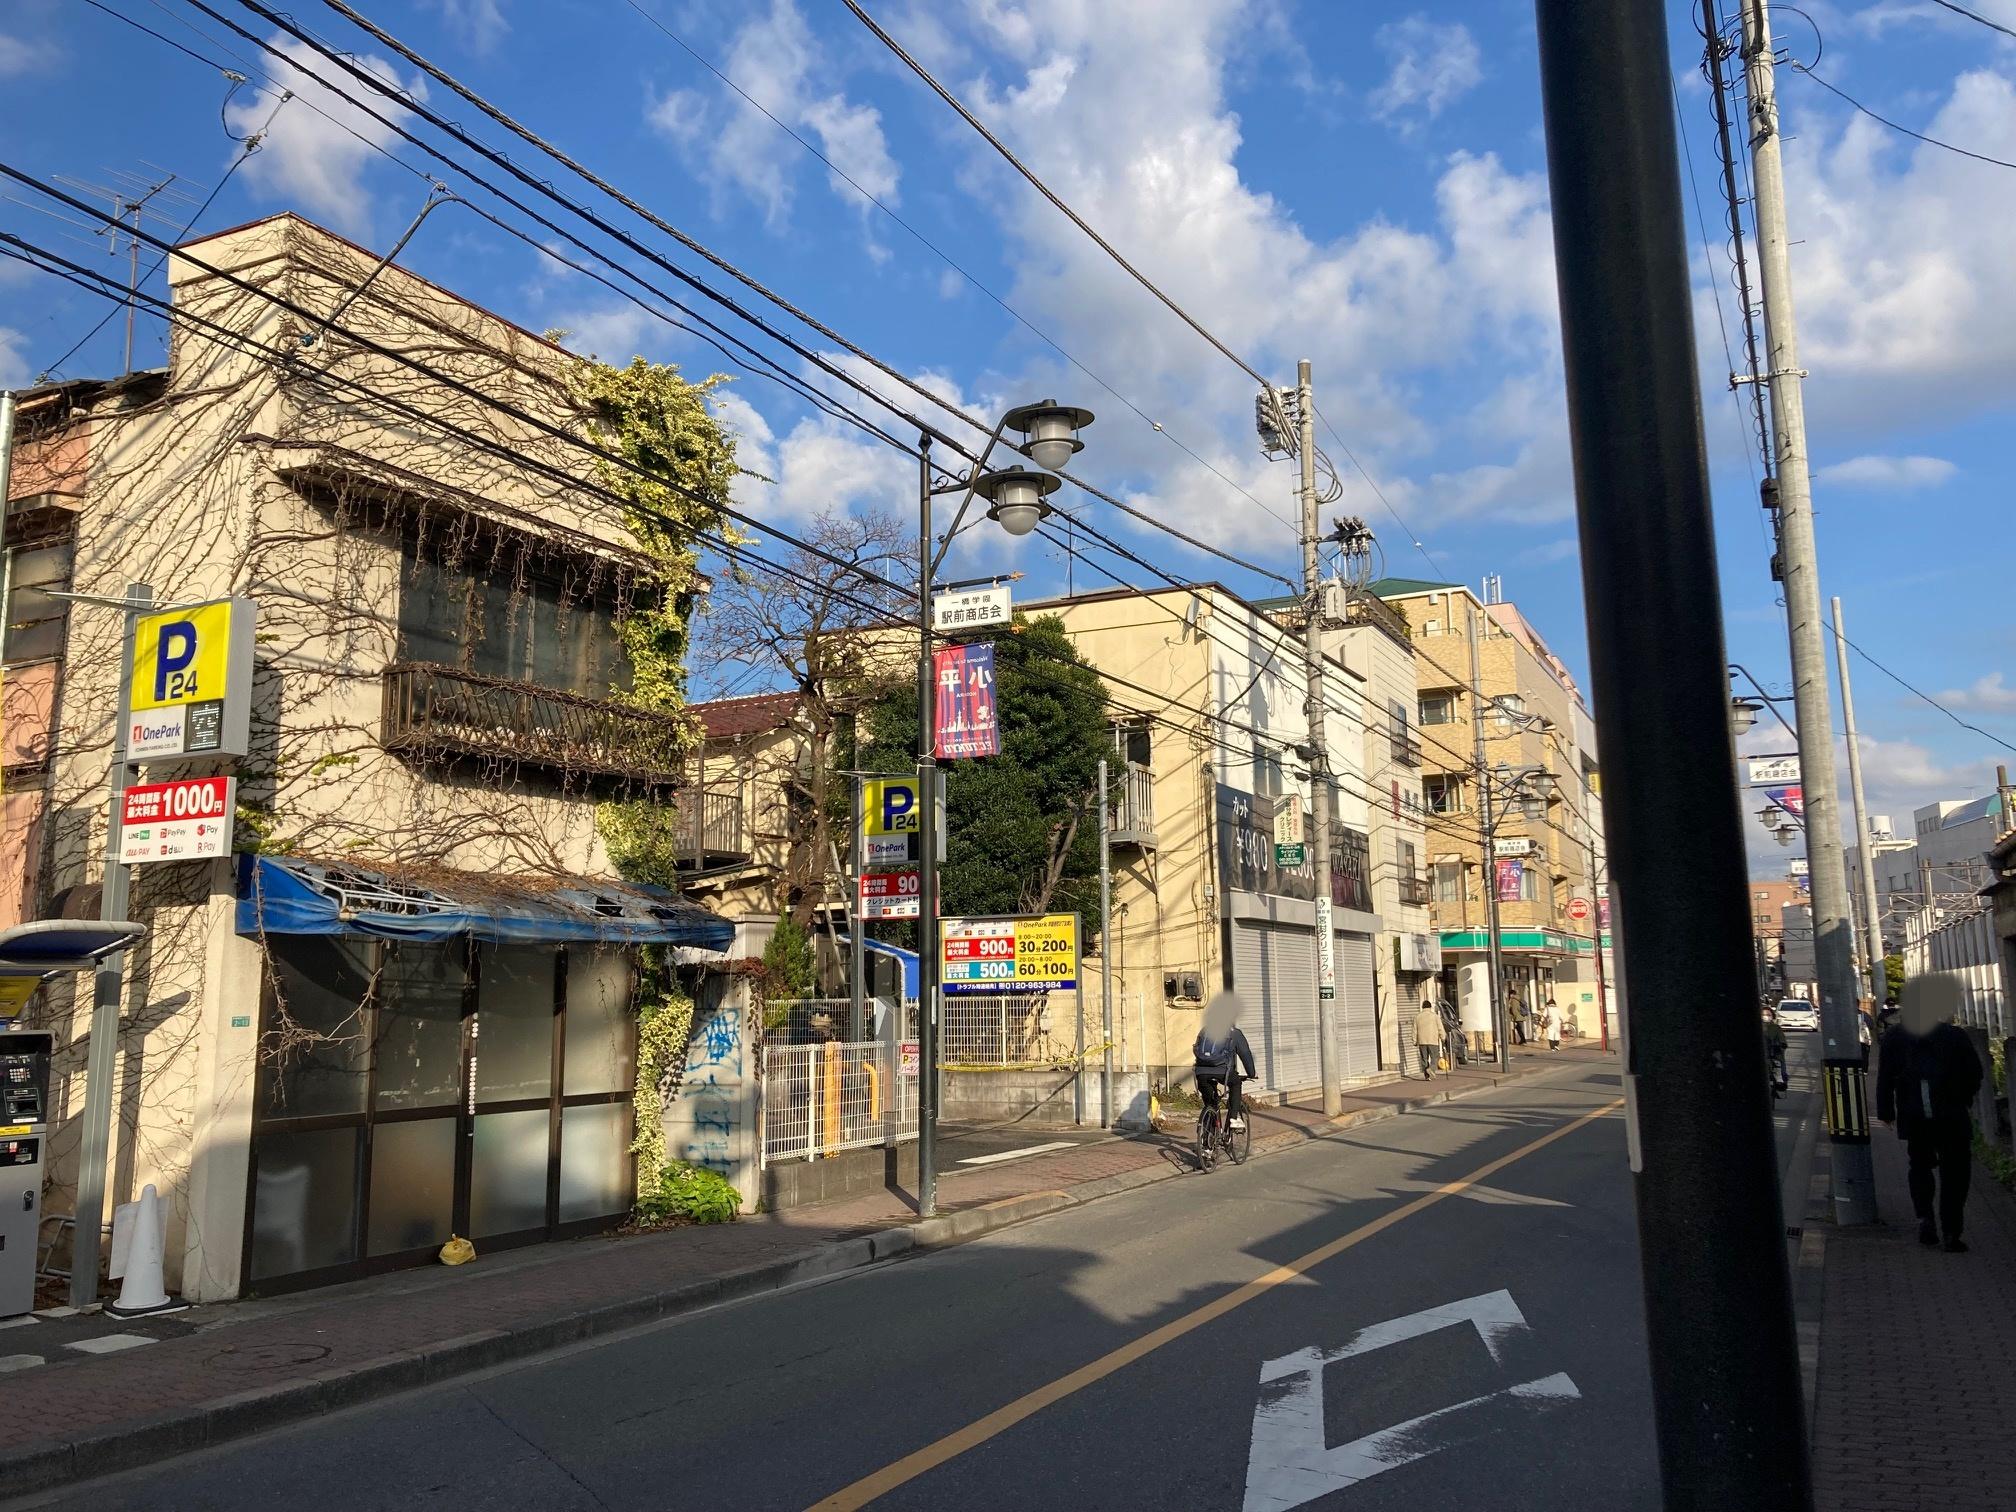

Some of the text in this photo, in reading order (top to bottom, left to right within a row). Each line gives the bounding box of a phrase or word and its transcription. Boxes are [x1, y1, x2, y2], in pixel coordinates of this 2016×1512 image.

[941, 604, 1002, 625] 駅前商店会
[154, 620, 197, 701] P
[170, 670, 198, 699] 24
[143, 722, 181, 742] OnePark
[163, 783, 223, 817] 1000円
[883, 785, 914, 831] P
[1232, 795, 1249, 819] カット
[895, 814, 917, 830] 24
[168, 828, 187, 837] PayPay
[875, 842, 905, 853] OnePark
[980, 939, 1014, 956] 900円
[980, 962, 1014, 978] 500円
